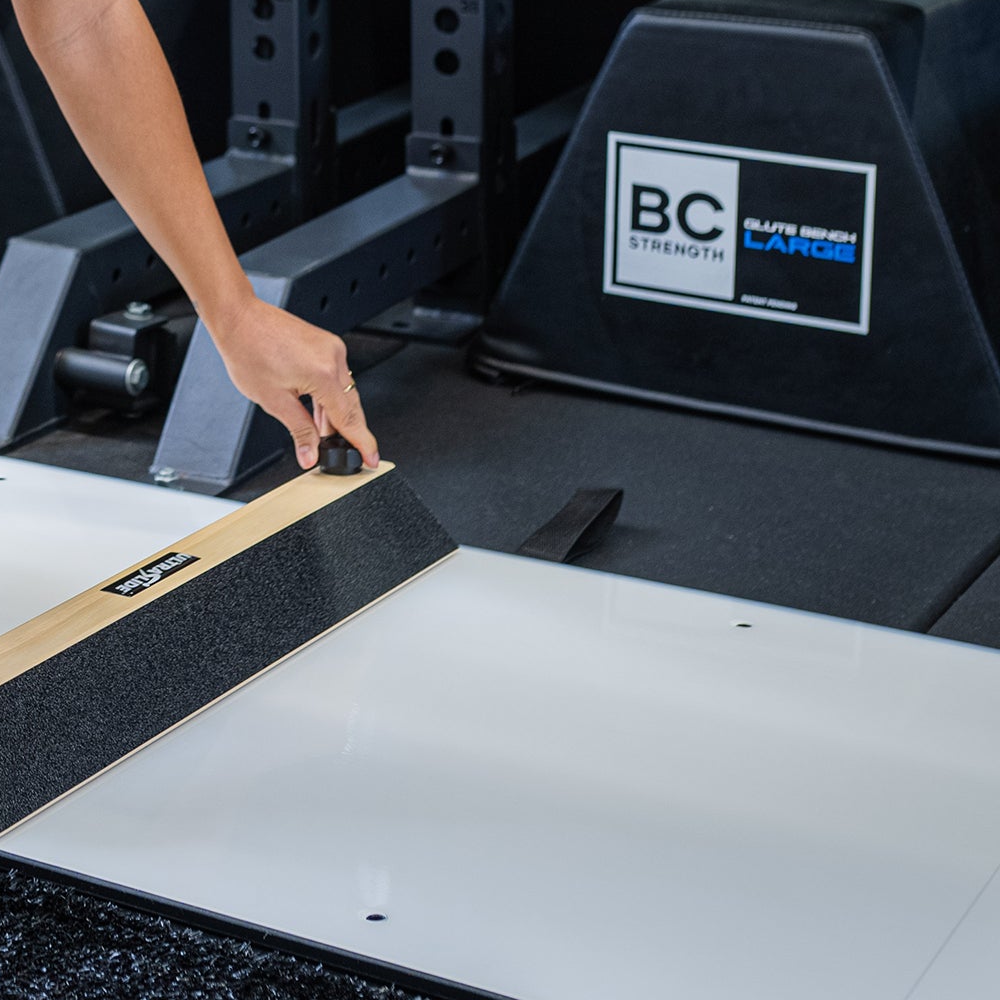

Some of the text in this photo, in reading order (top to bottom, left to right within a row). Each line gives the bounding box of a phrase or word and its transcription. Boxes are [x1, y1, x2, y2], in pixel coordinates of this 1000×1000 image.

[631, 183, 724, 242] BC
[743, 217, 857, 244] GLUTE BENCH
[629, 236, 725, 262] STRENGTH
[743, 230, 857, 264] LARGE
